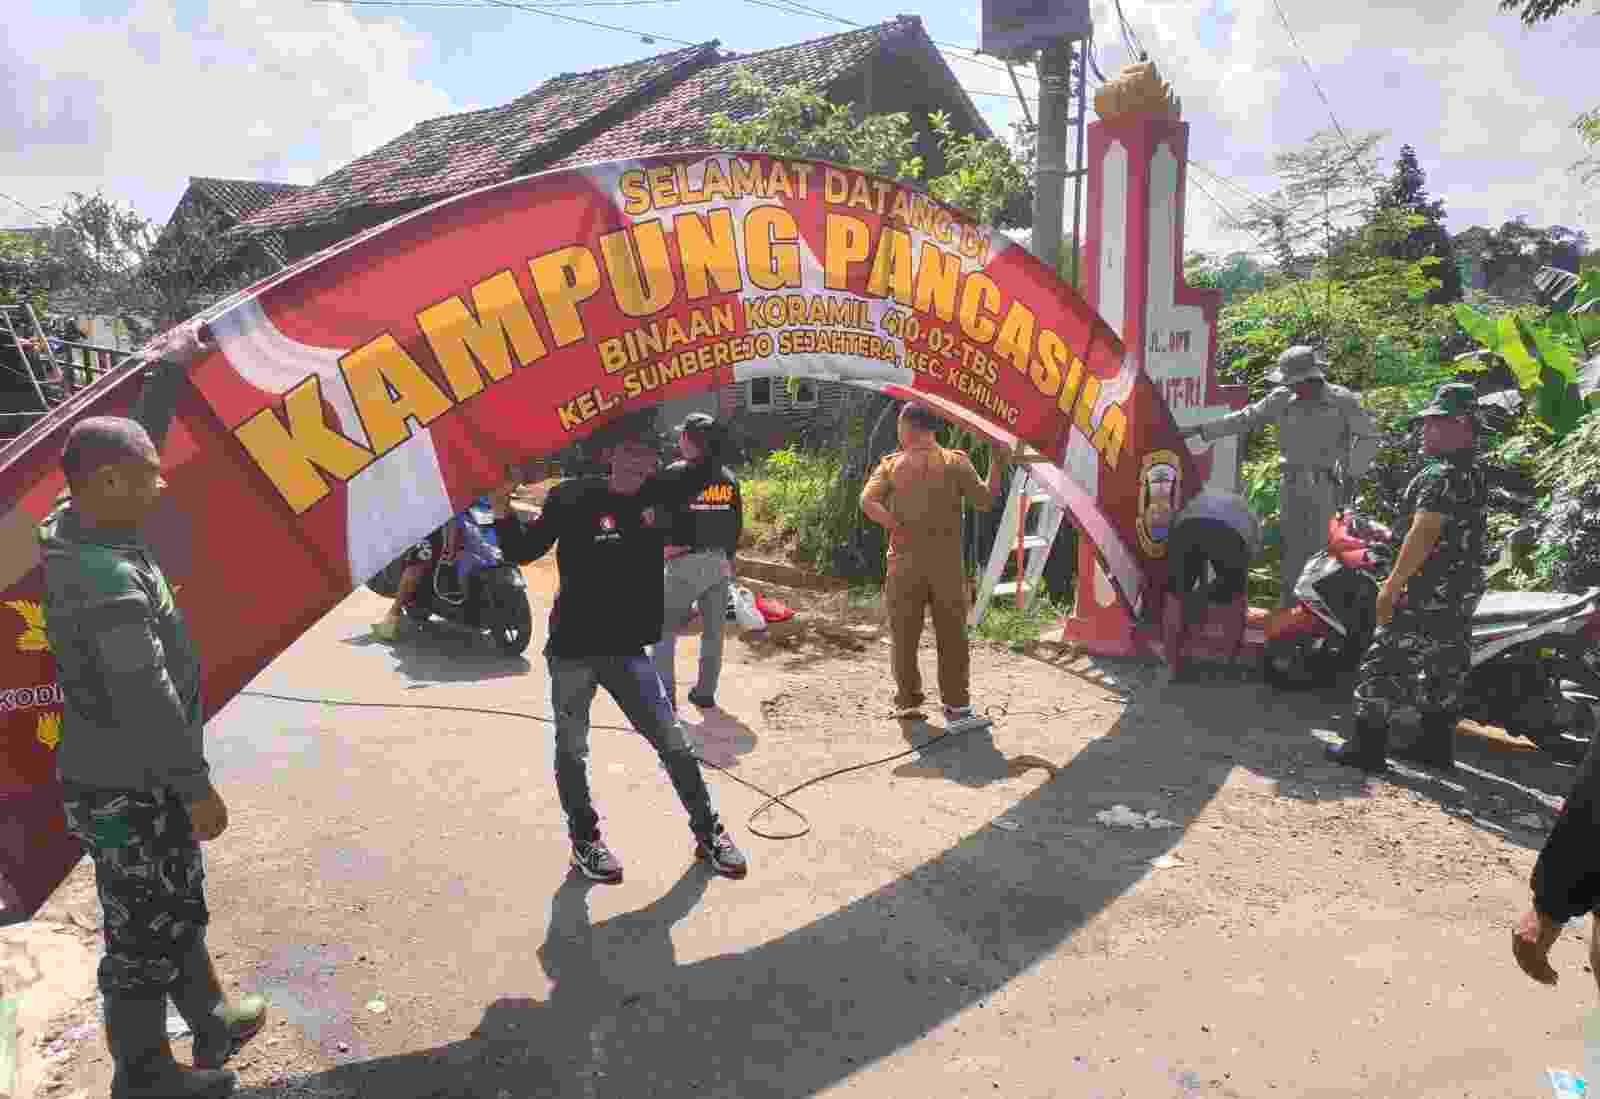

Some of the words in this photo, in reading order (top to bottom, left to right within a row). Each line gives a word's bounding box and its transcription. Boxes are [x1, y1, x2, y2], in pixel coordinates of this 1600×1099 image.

[619, 157, 813, 216] SELAMAT
[823, 166, 956, 242] DATANG
[234, 204, 801, 515] KAMPUNG
[823, 210, 1130, 471] PANCASILA
[598, 306, 737, 374] BINAAN
[743, 294, 874, 330] KORAMIL
[622, 331, 774, 399] SUMBEREJO
